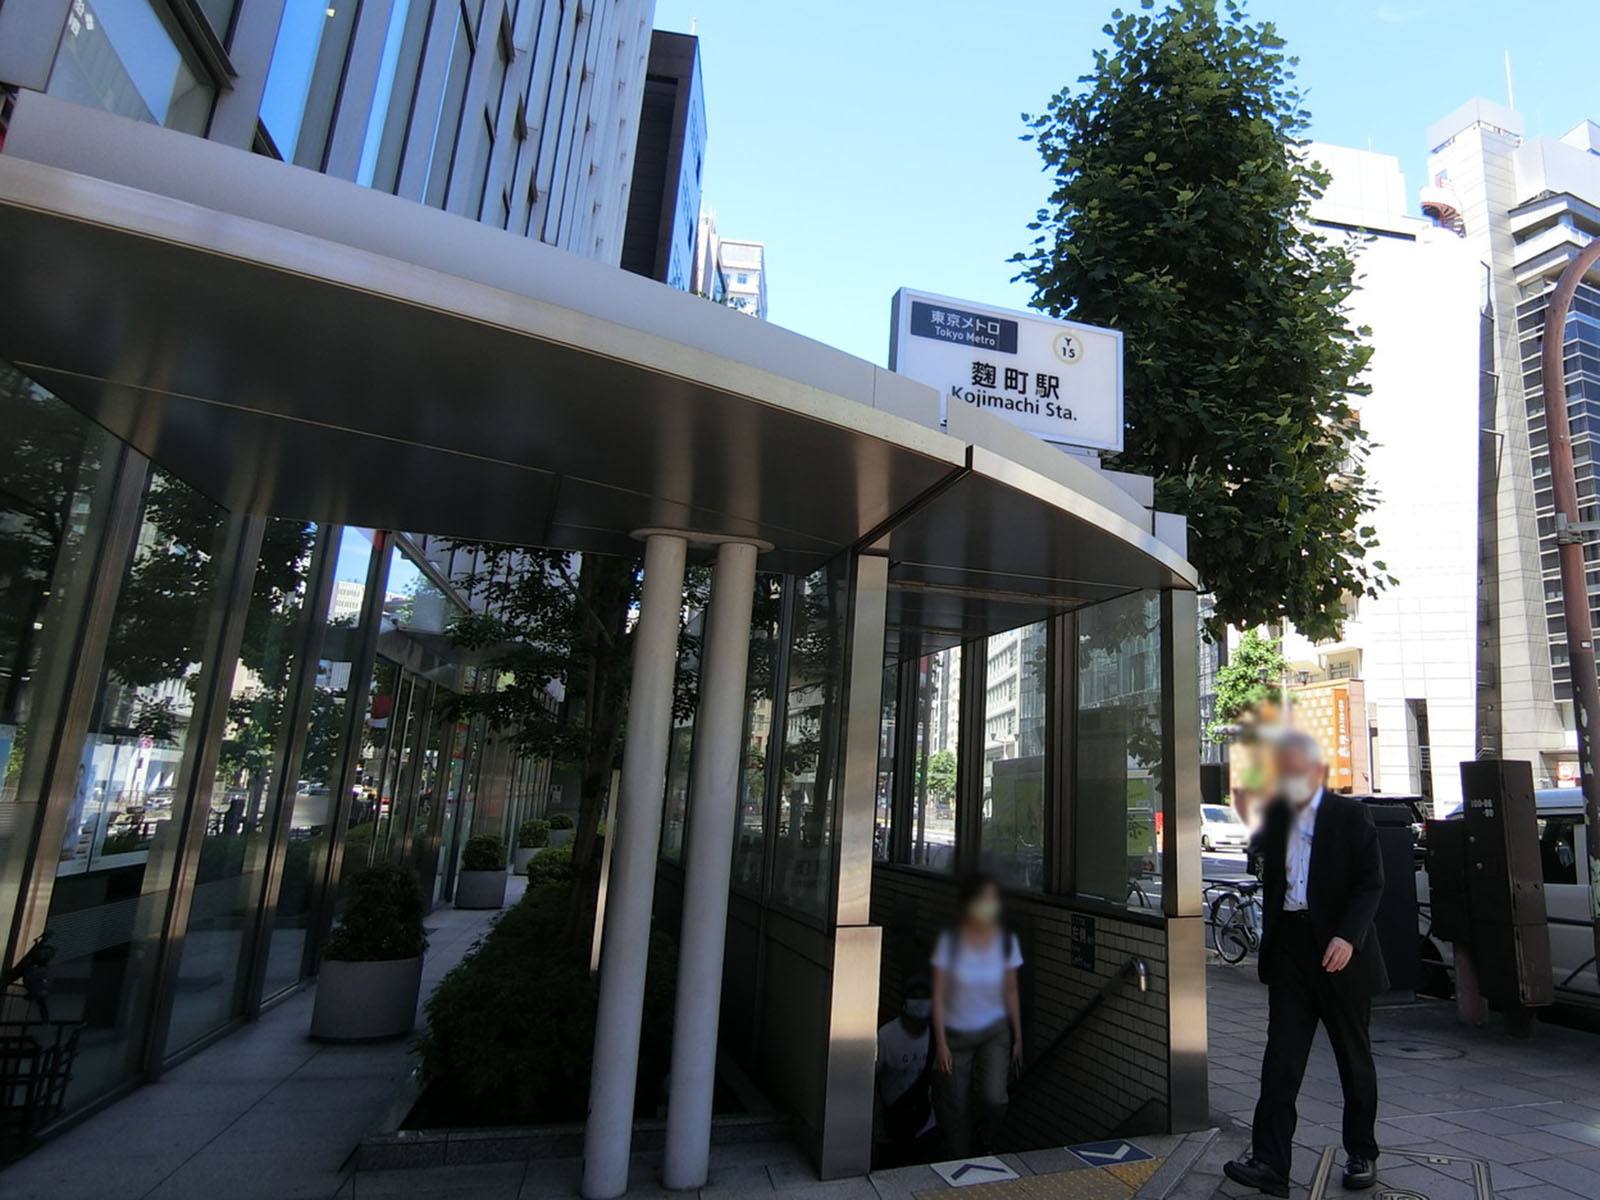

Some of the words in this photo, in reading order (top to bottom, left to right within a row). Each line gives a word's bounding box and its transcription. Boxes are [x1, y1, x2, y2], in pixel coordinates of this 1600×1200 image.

[931, 311, 1000, 334] 東京メトロ
[935, 326, 964, 341] Tokyo
[966, 332, 996, 346] Metro
[1064, 337, 1072, 346] Y
[1062, 347, 1076, 358] 15
[952, 386, 1040, 414] Kojimachi
[1046, 403, 1078, 421] Sta.
